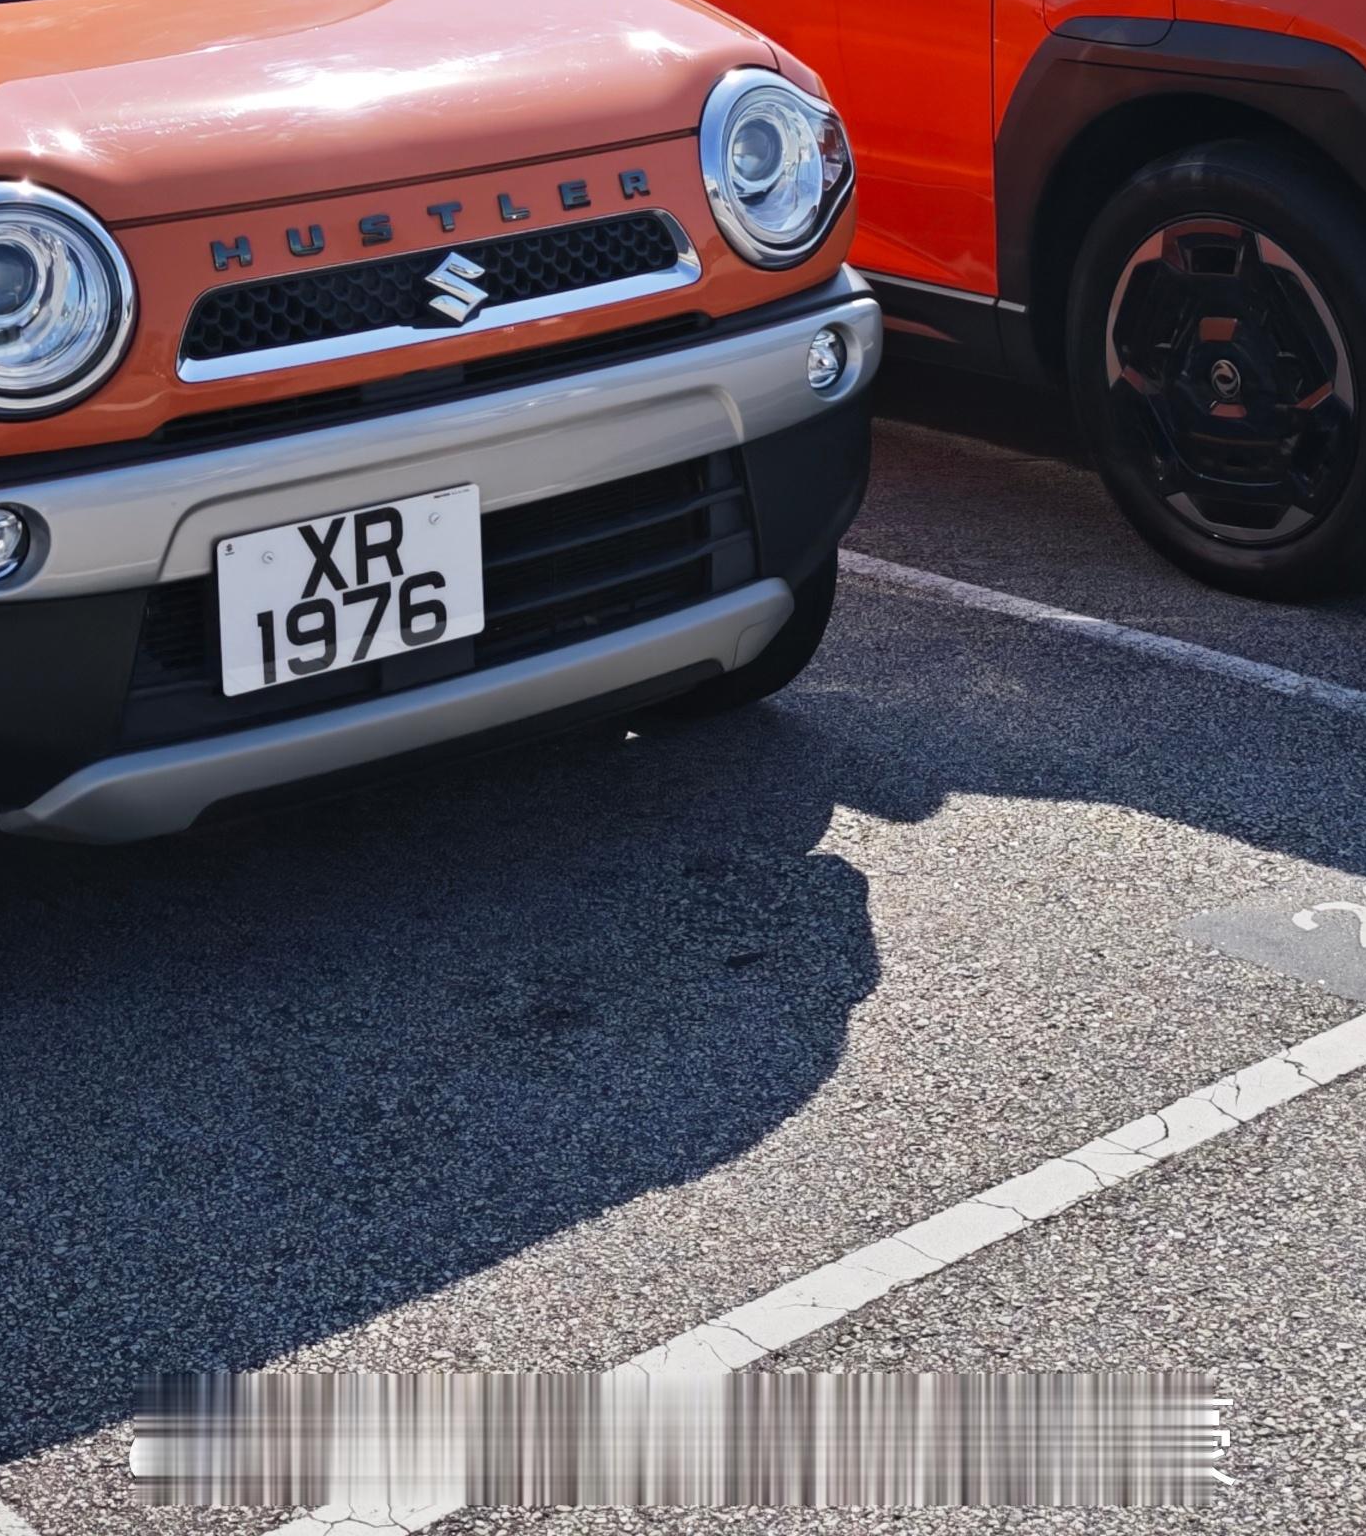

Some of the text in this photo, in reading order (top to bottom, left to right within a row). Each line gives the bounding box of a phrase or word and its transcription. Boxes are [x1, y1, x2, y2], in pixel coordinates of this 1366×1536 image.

[210, 169, 651, 271] HUSTLER
[297, 507, 404, 599] XR
[257, 571, 447, 685] 1976
